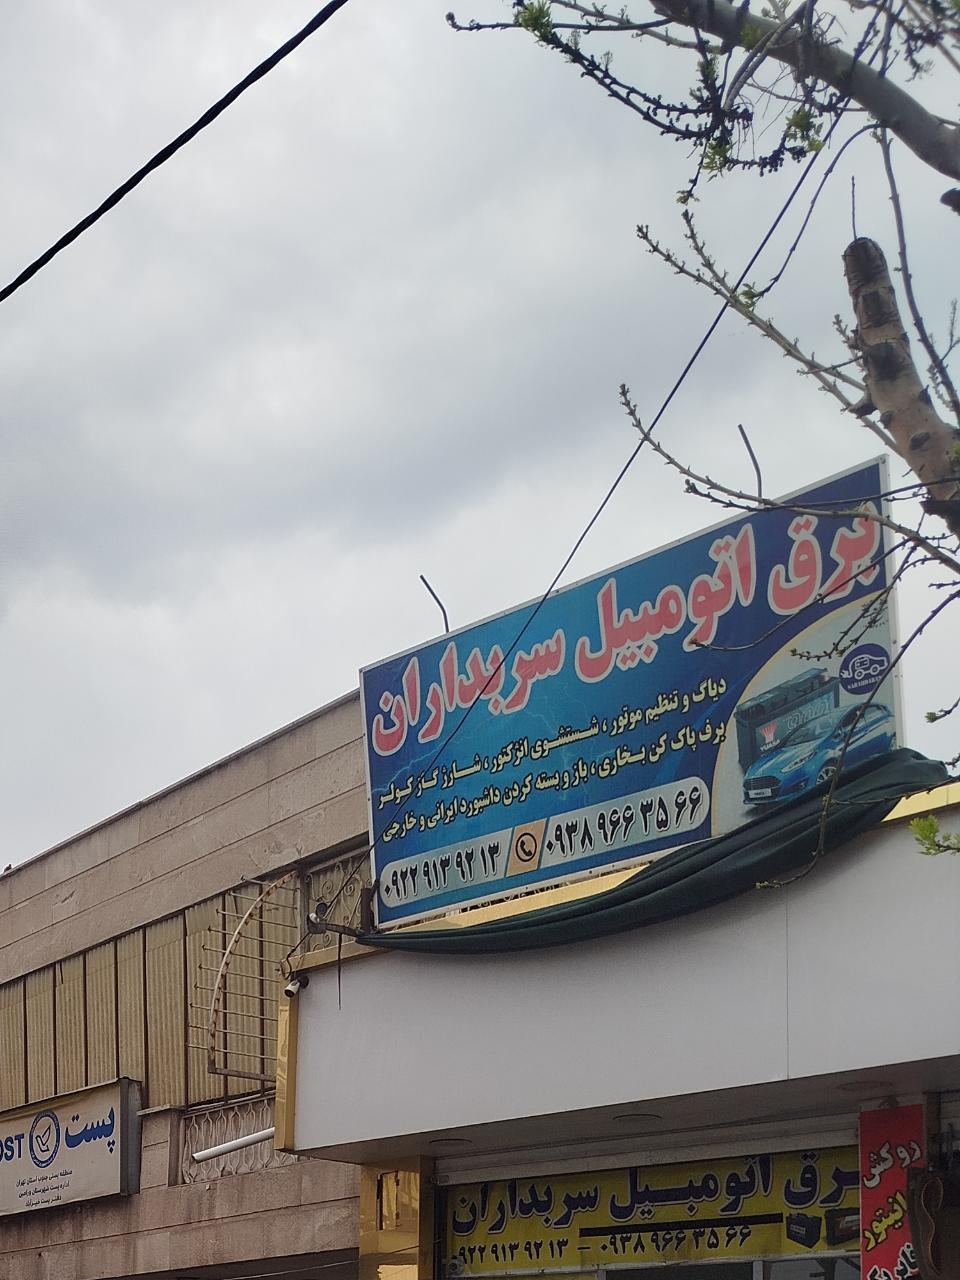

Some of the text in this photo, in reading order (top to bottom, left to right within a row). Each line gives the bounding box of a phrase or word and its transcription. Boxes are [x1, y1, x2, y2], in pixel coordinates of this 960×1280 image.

[371, 502, 881, 757] برق اتومبیل سربداران
[682, 694, 689, 713] و
[692, 677, 727, 703] دیاگ
[611, 705, 643, 736] موتور
[645, 690, 679, 724] تنظیم
[648, 733, 668, 763] کن
[670, 725, 697, 751] پاک
[699, 719, 727, 745] برف
[441, 753, 482, 789] شارژ
[572, 758, 589, 787] باز
[598, 745, 646, 778] بخاری
[378, 776, 414, 810] کولر
[415, 767, 439, 797] گاز
[503, 773, 533, 806] کردن
[534, 769, 560, 792] بسته
[562, 769, 570, 789] و
[427, 797, 458, 829] ایرانی
[458, 782, 501, 818] داشبورد
[382, 810, 418, 843] خارجی
[418, 814, 426, 833] و
[546, 816, 594, 855] ۰۹۳۸
[674, 785, 702, 827] ۶۶
[480, 841, 500, 876] ۱۳
[65, 1106, 117, 1155] پست
[863, 1140, 922, 1189] روکش
[452, 1151, 859, 1236] رق اتومبیل سربداران
